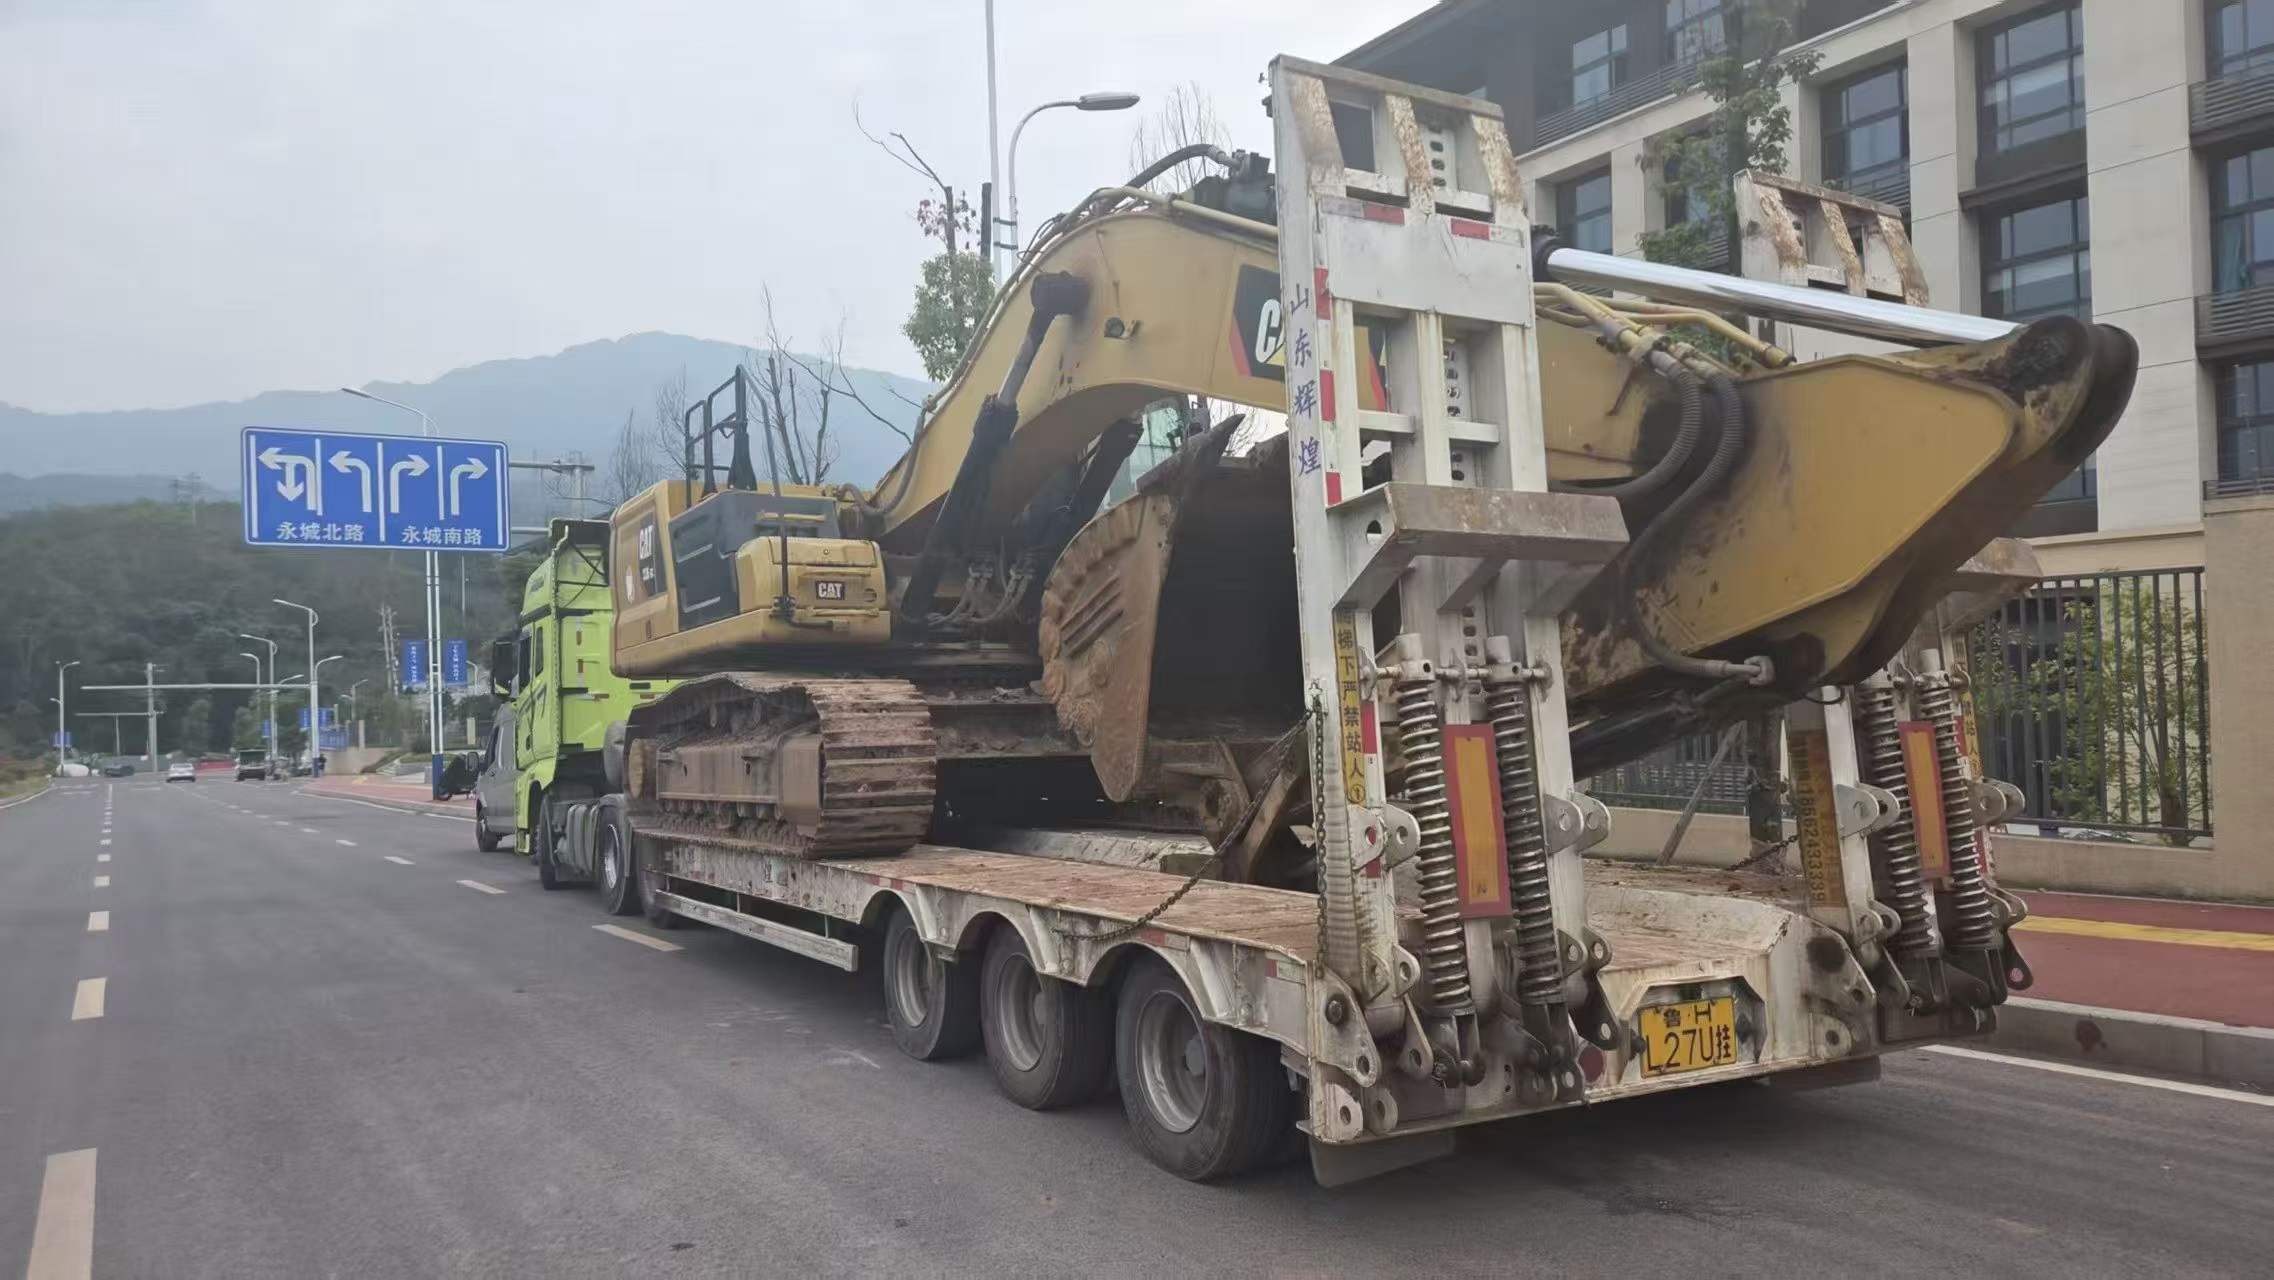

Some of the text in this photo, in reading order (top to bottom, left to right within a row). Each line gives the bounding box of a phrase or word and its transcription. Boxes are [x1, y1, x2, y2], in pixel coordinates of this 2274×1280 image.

[1290, 283, 1322, 477] 山东辉煌
[277, 521, 364, 542] 永城北路
[402, 526, 483, 545] 永城南路
[818, 582, 842, 599] CAT
